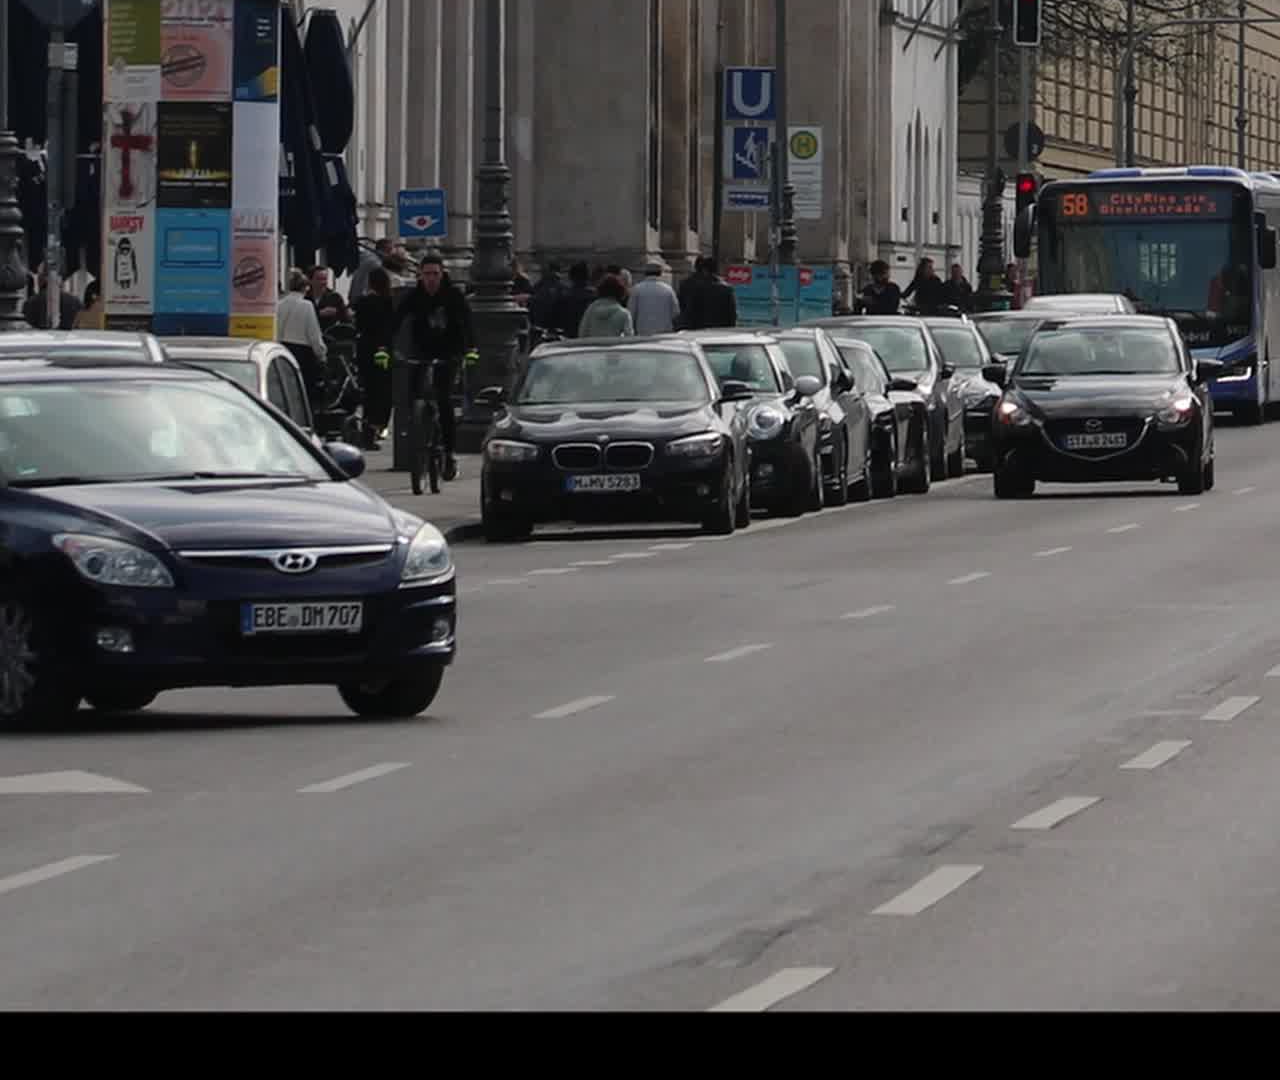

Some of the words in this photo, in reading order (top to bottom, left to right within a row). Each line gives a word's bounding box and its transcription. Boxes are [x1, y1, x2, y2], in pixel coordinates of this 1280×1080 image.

[732, 71, 771, 116] U
[1062, 193, 1088, 217] 58
[254, 606, 288, 628] EBE
[301, 605, 324, 627] DM
[327, 604, 360, 625] 707
